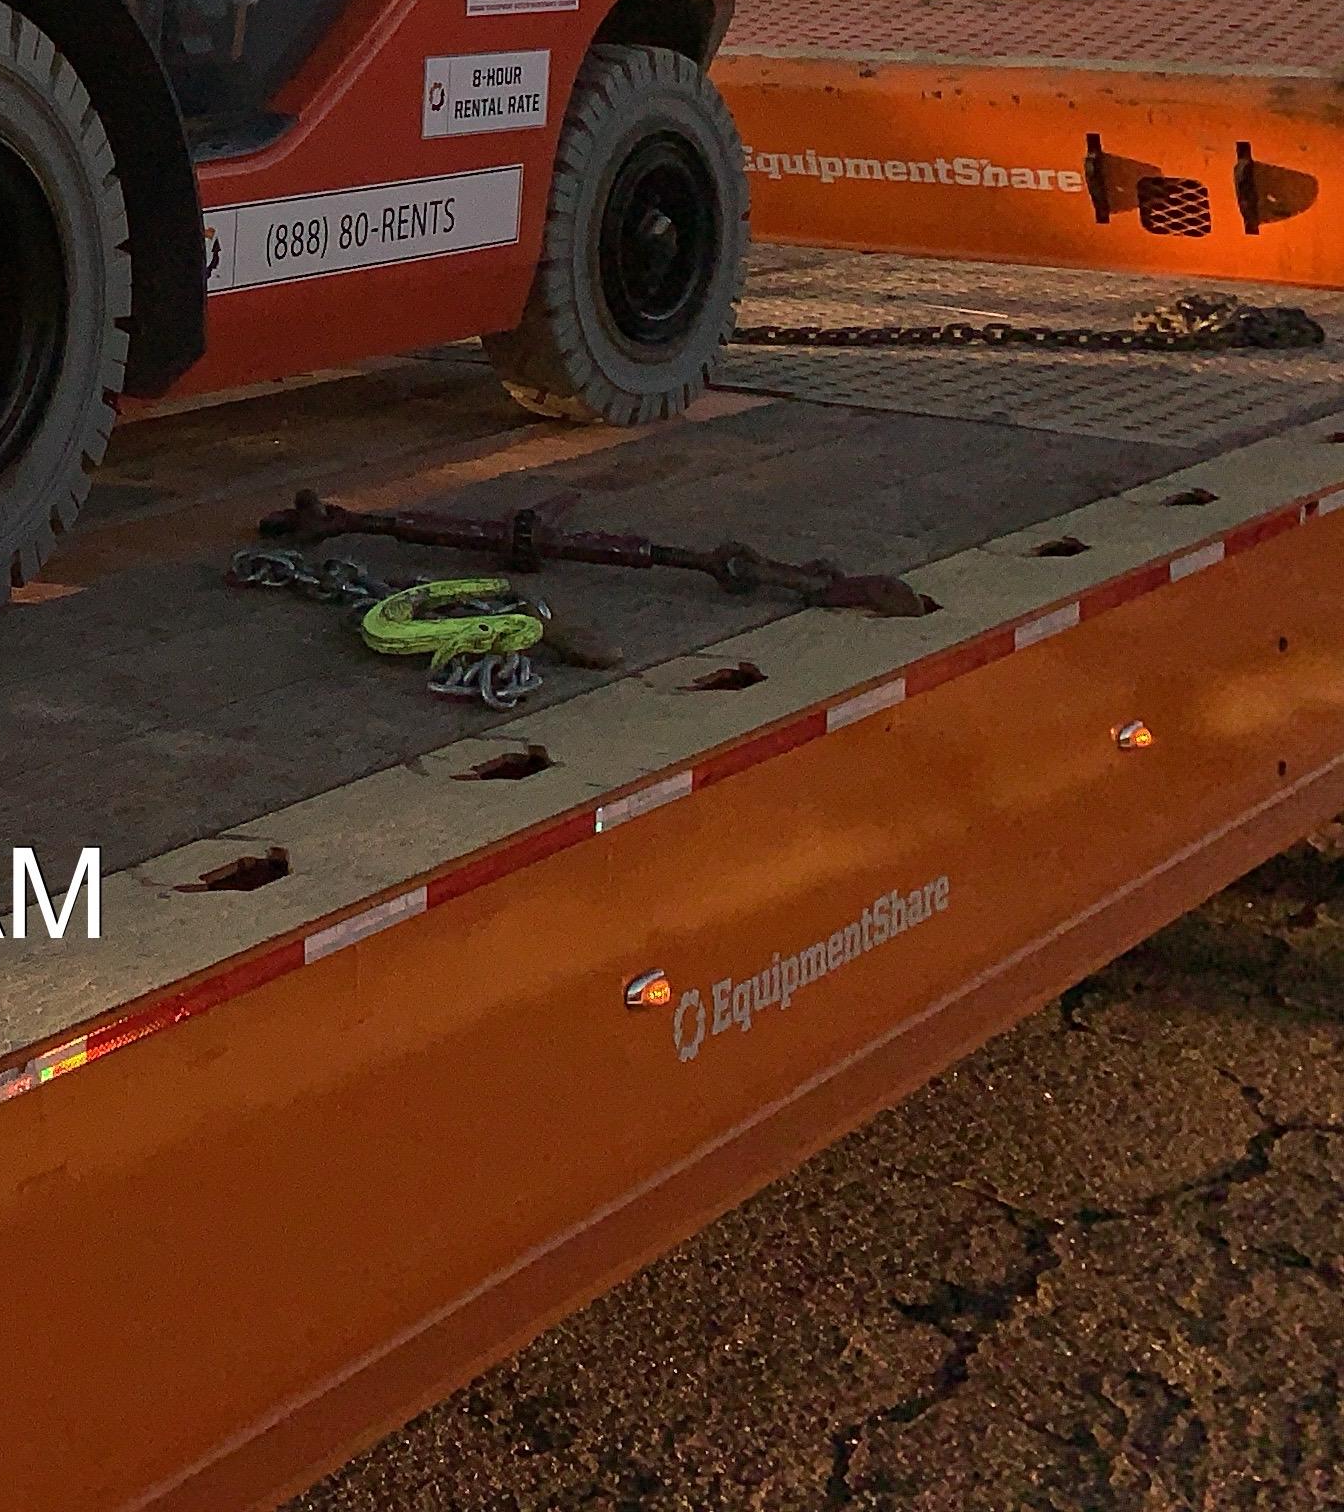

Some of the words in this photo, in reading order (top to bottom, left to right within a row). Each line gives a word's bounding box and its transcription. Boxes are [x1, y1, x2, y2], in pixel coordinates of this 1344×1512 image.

[472, 66, 522, 88] 8-HOUR
[454, 96, 504, 119] RENTAL
[508, 93, 540, 114] RATE
[266, 216, 328, 267] (888)
[339, 197, 456, 250] 80-RENTS
[711, 876, 950, 1035] EquipmentShare
